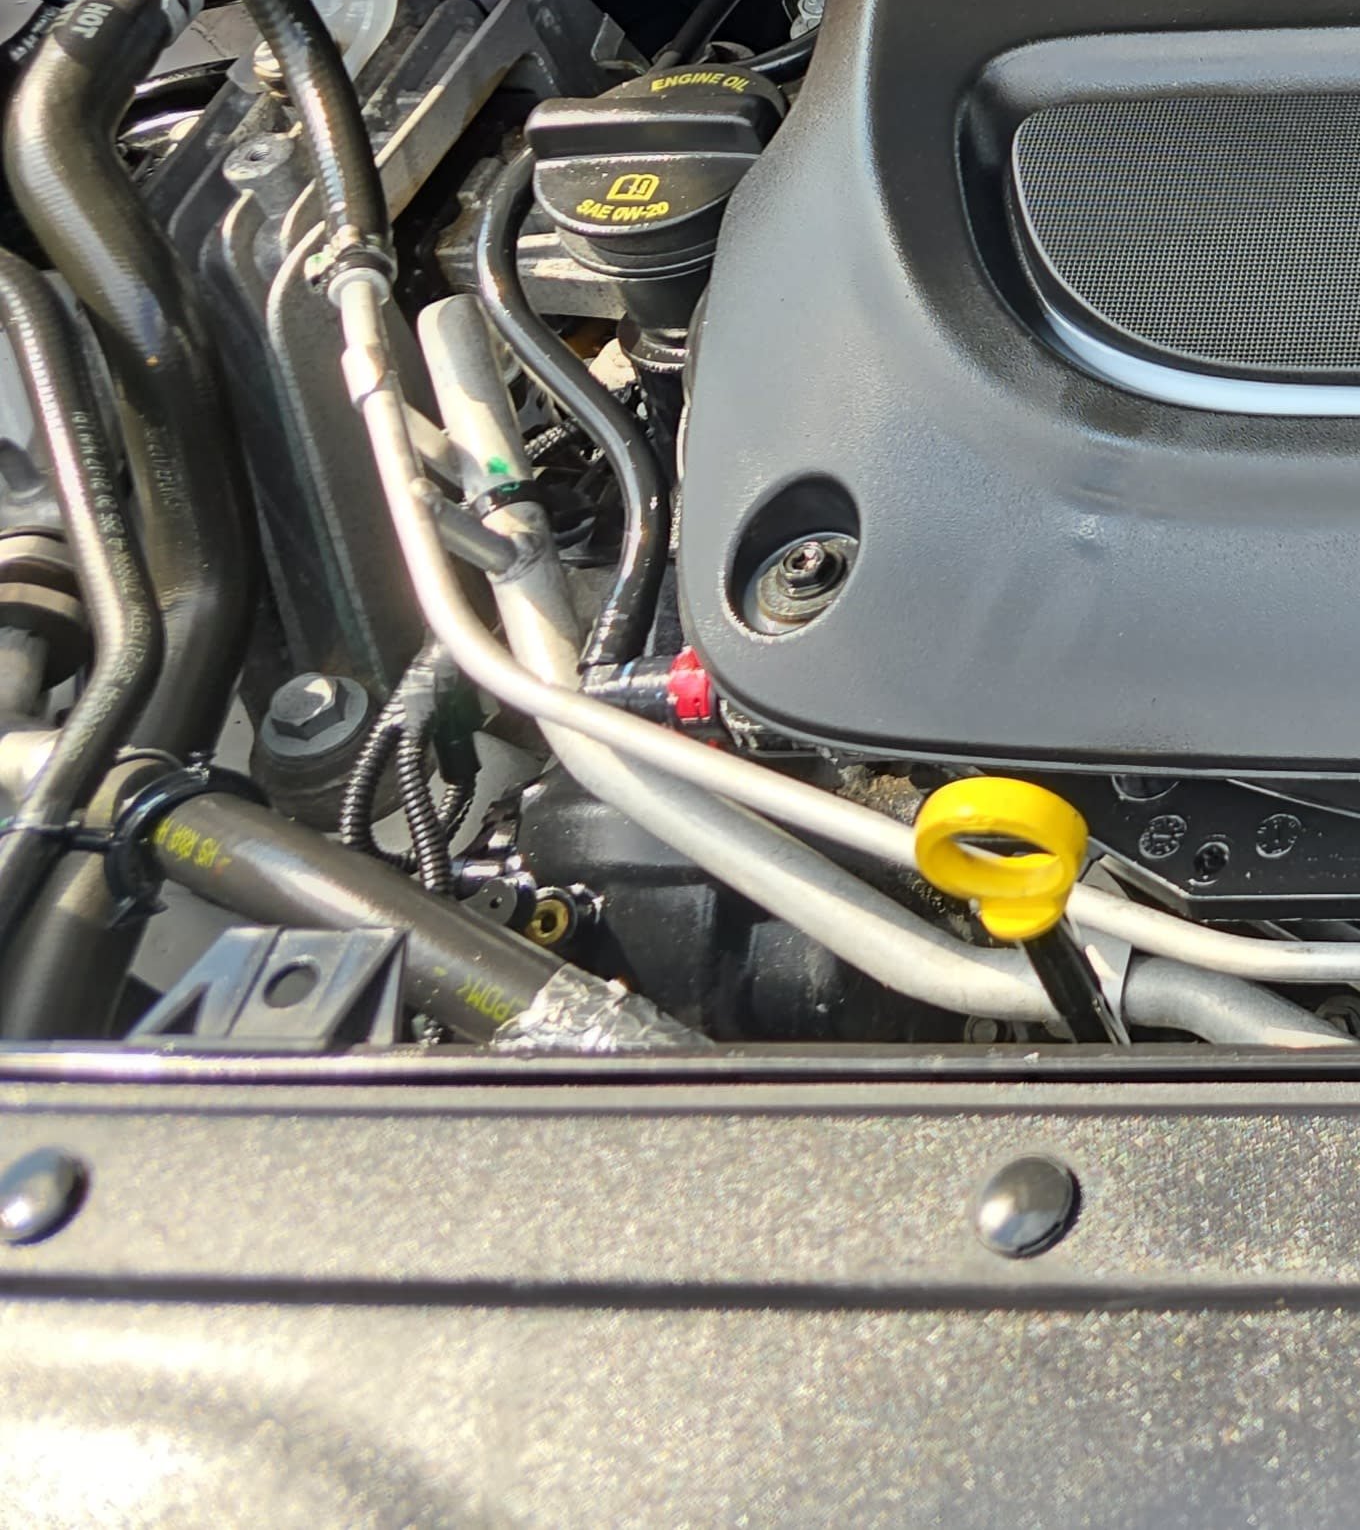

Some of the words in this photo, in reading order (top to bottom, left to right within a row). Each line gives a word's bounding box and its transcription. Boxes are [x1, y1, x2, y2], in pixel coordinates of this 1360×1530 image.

[71, 2, 114, 39] HOT
[651, 72, 726, 93] ENGINE
[721, 76, 750, 93] OIL
[575, 199, 613, 221] SAE
[611, 201, 670, 221] 0W-20
